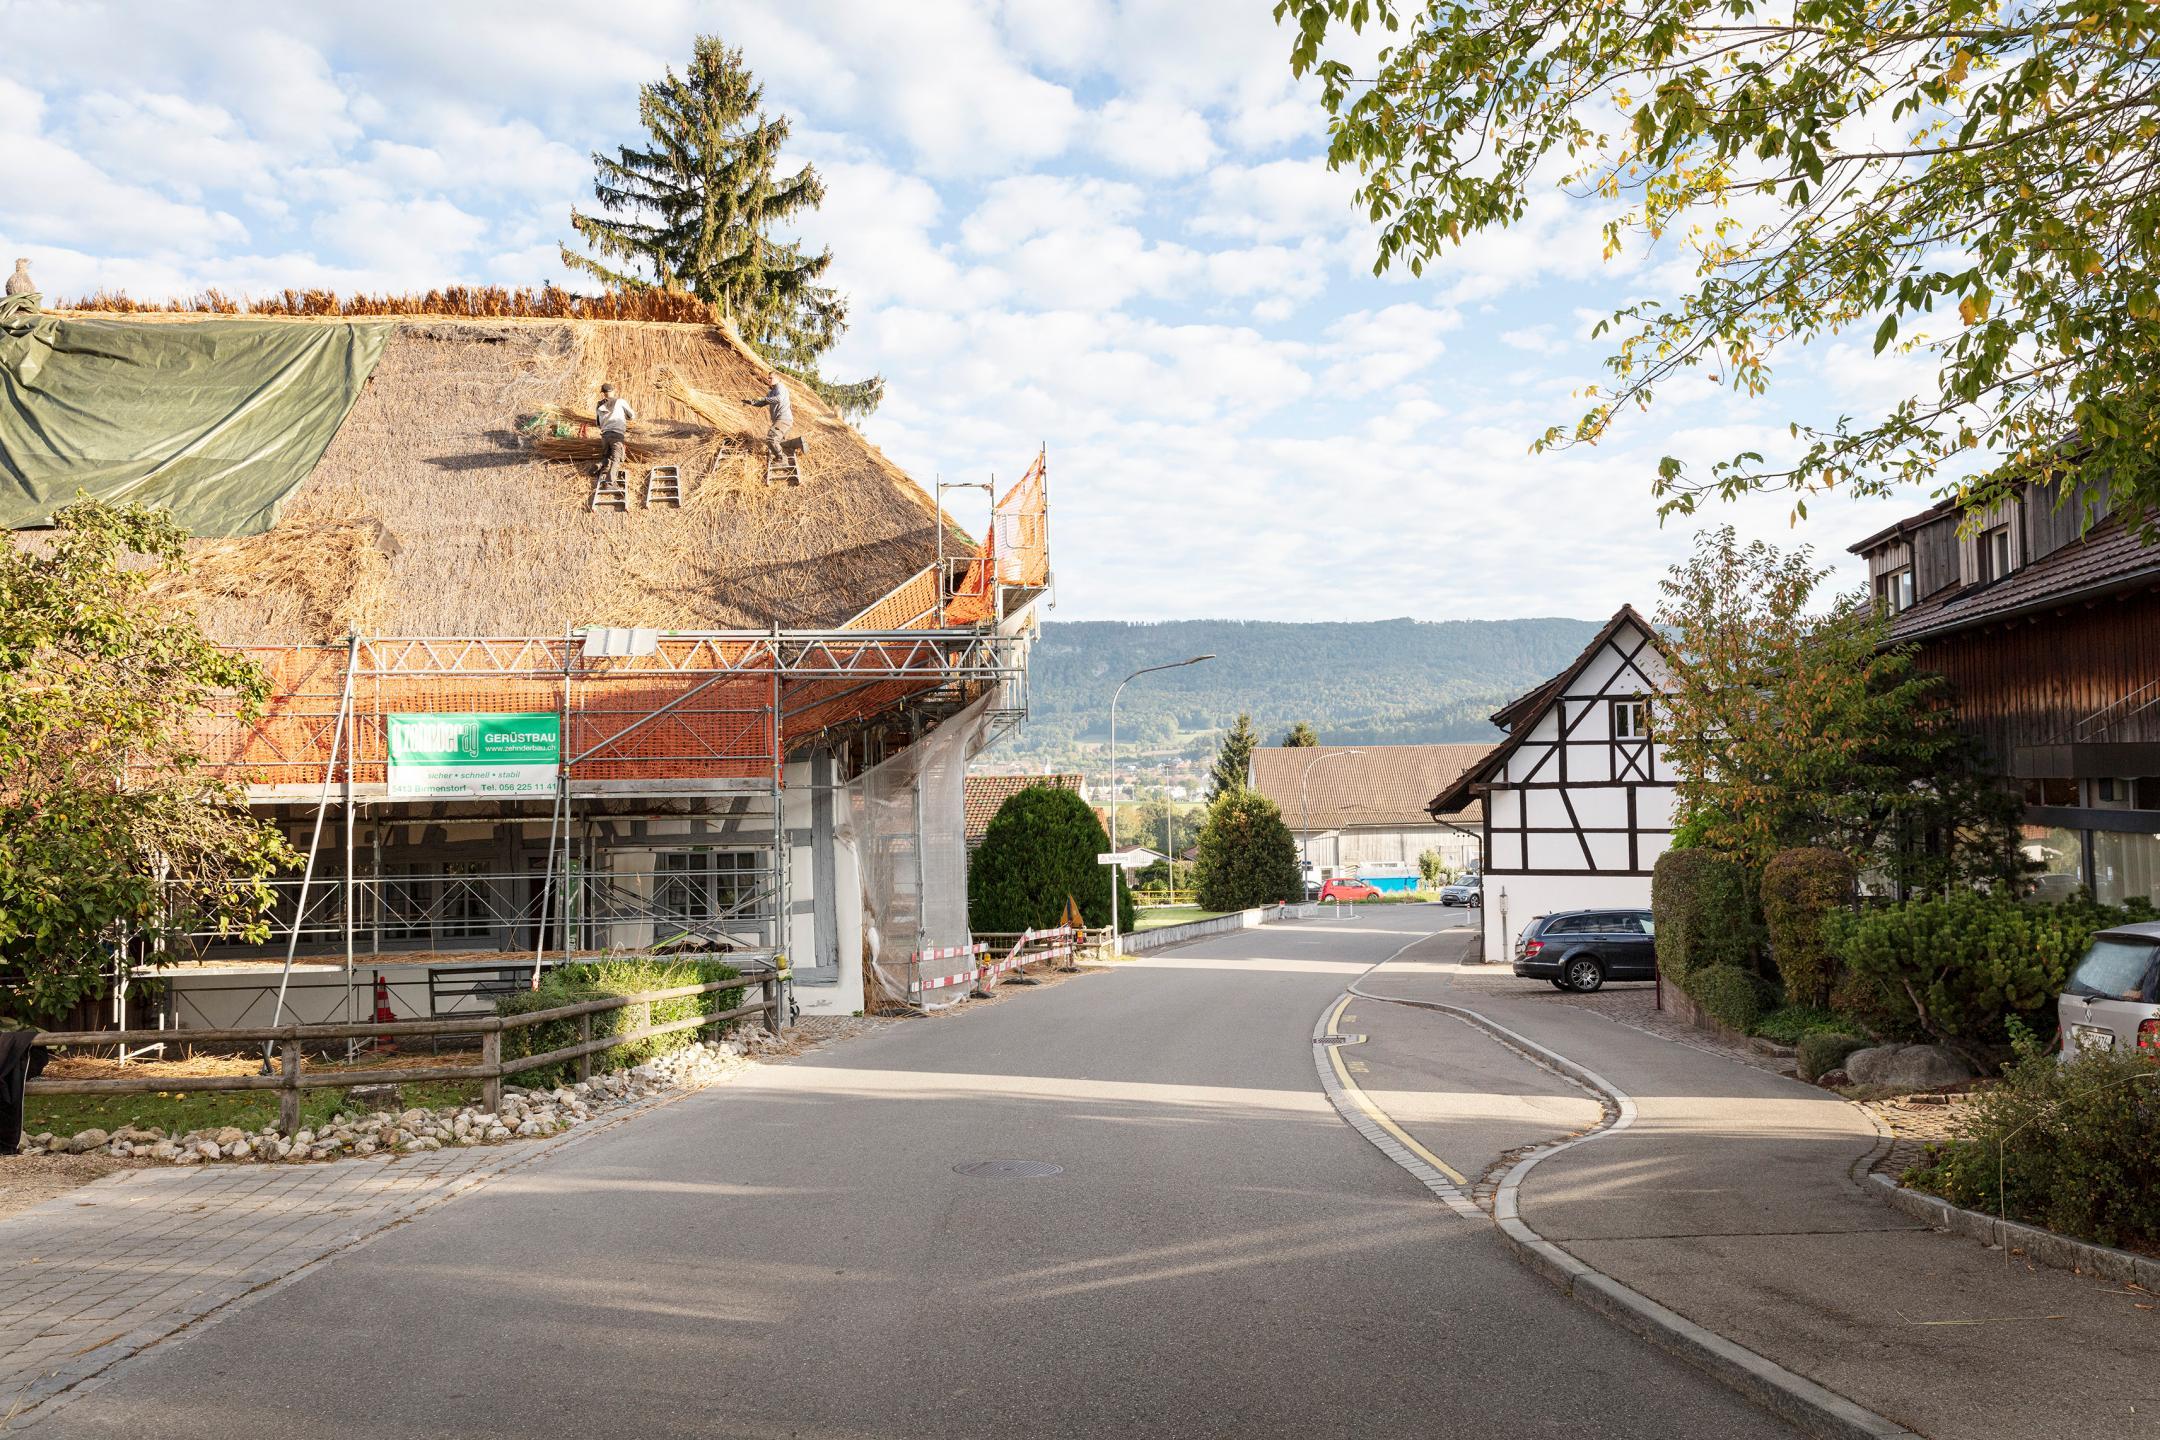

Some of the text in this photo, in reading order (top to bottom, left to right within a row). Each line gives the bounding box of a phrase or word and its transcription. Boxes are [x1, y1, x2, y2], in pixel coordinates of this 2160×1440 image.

[485, 732, 556, 743] GERÜSTBAU
[460, 771, 490, 779] schnell
[498, 771, 521, 779] stabil
[415, 784, 466, 792] Birmenstorf
[481, 784, 497, 792] Tel.
[499, 783, 515, 791] 056
[517, 783, 532, 791] 225
[534, 783, 545, 791] 11
[547, 783, 556, 791] 41
